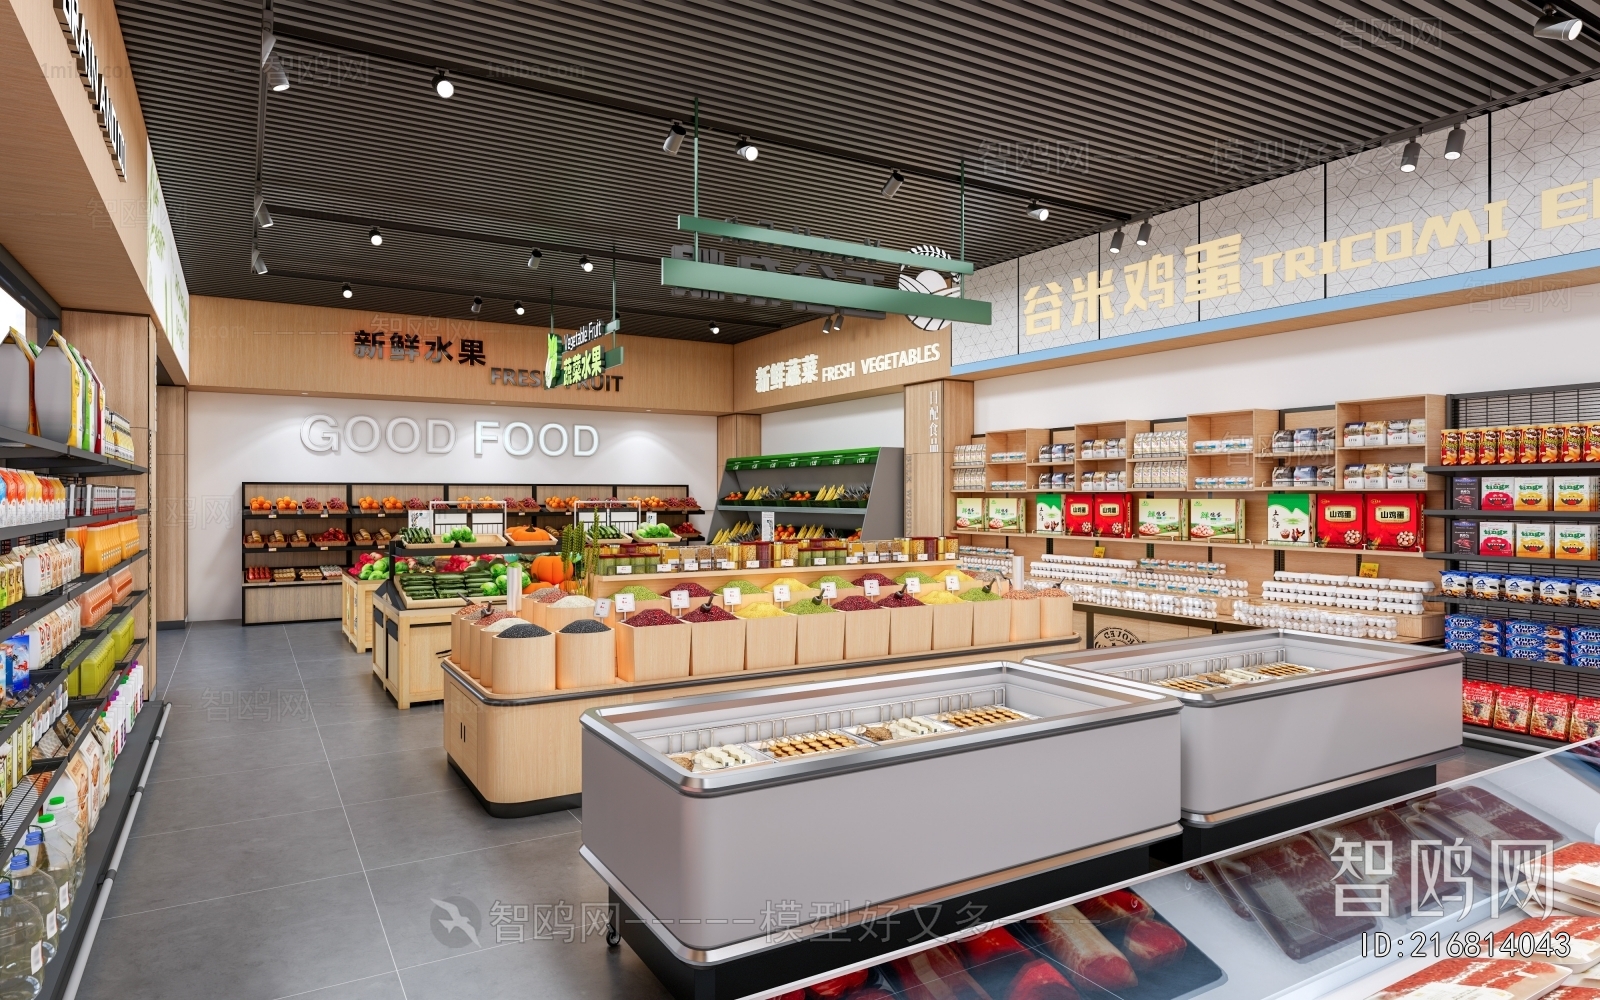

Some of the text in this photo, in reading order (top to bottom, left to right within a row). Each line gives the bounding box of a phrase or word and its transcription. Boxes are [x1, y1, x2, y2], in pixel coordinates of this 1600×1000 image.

[1253, 200, 1509, 287] TRICOMI
[1023, 233, 1242, 336] 谷米鸡蛋
[353, 329, 486, 367] 新鲜水果
[563, 319, 602, 351] Vegetable Fruit
[490, 367, 547, 388] FRES
[563, 345, 602, 386] 蔬菜水果
[756, 354, 819, 393] 新鲜蔬菜
[822, 343, 941, 382] FRESH VEGETABLES
[300, 414, 600, 457] GOOD FOOD
